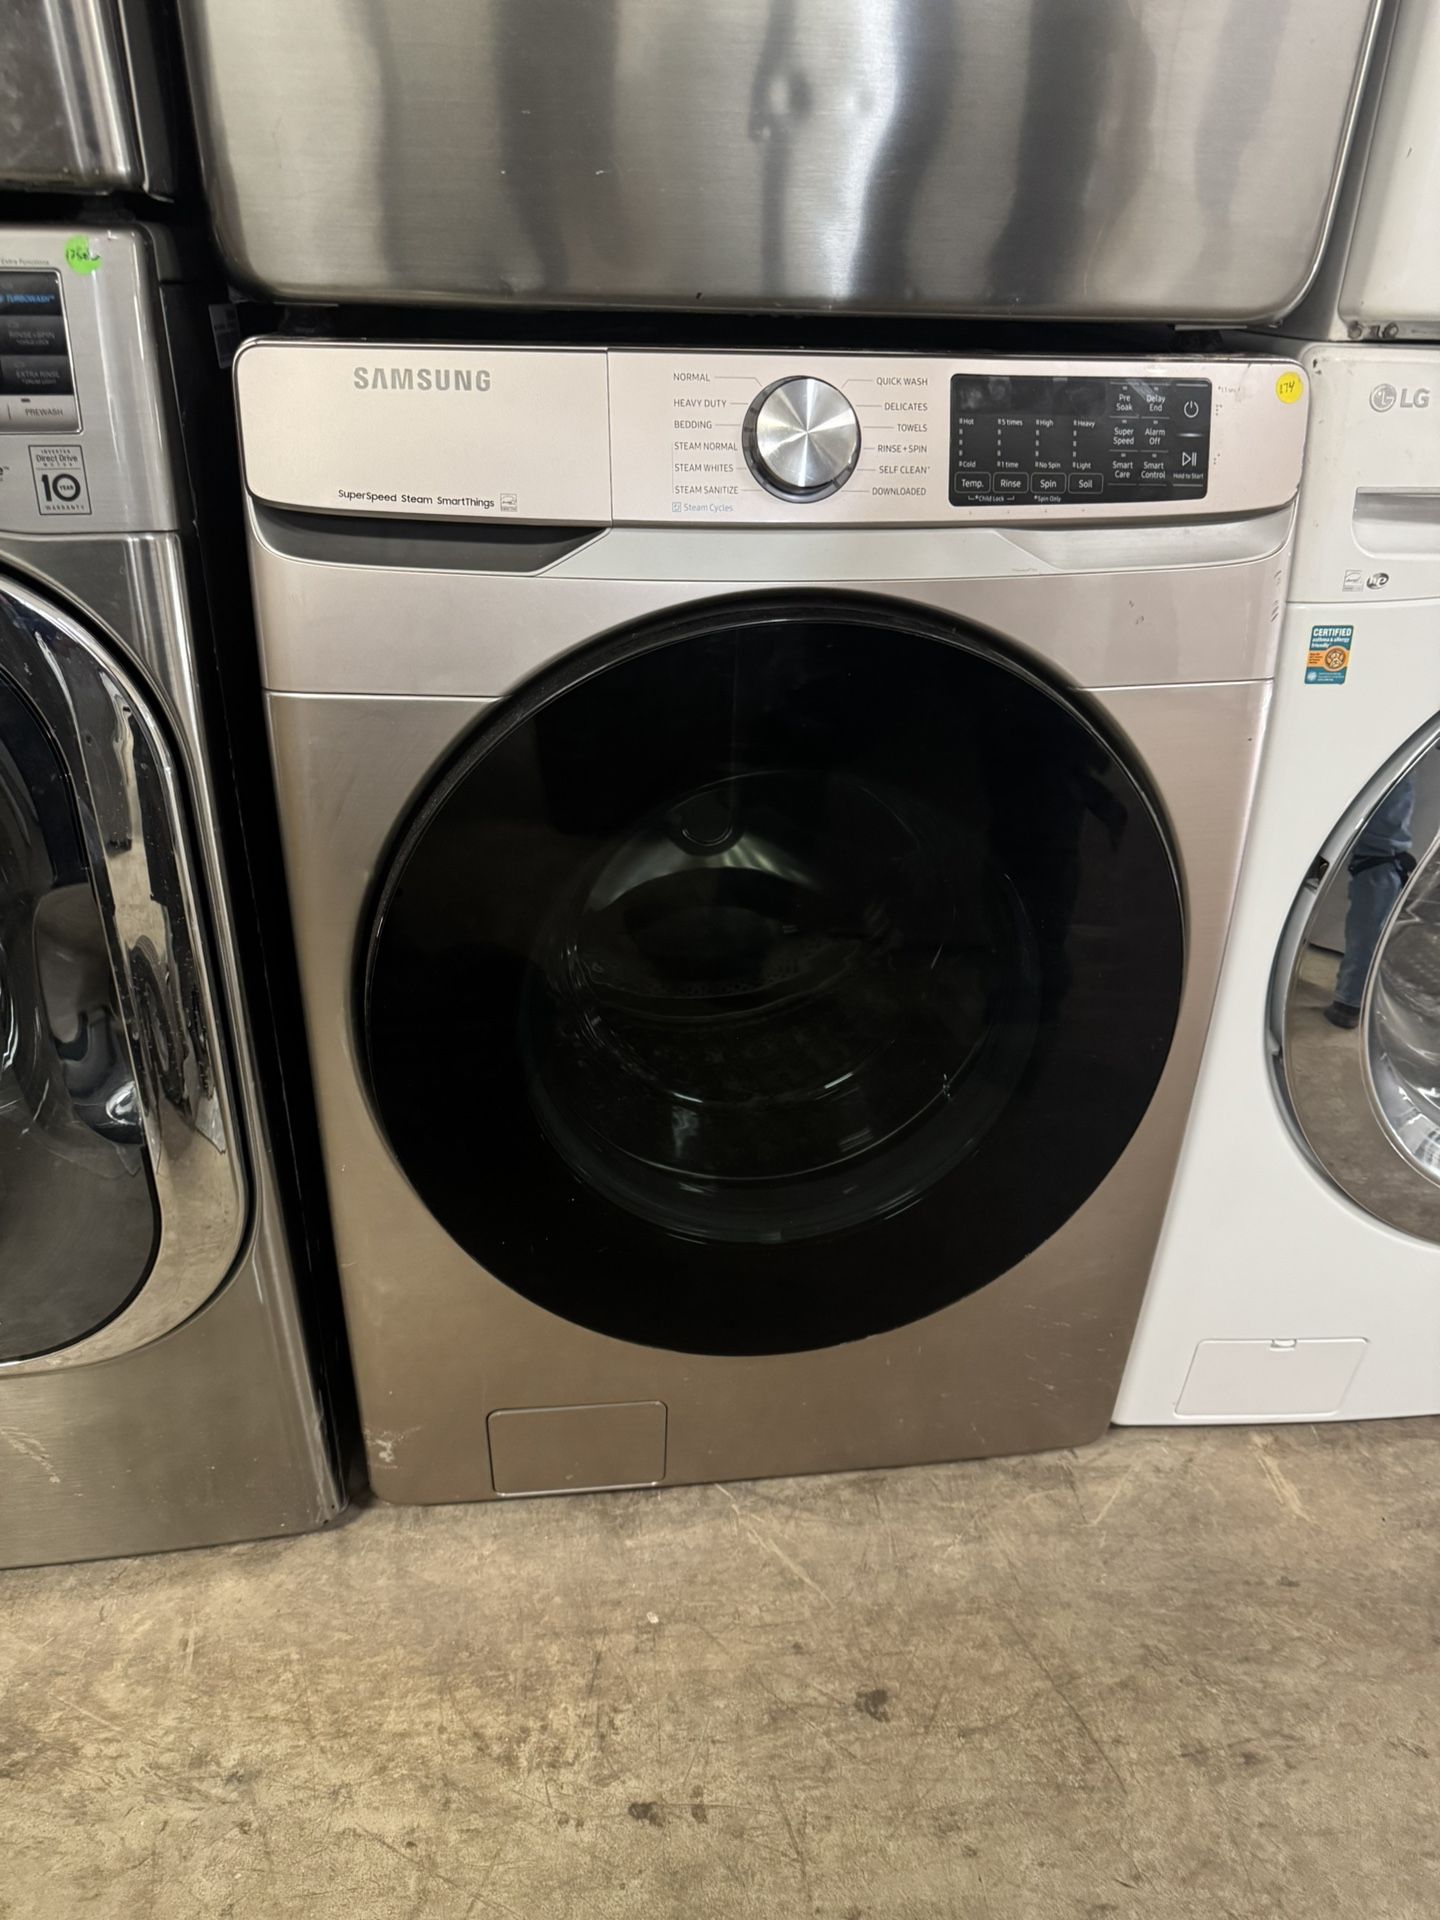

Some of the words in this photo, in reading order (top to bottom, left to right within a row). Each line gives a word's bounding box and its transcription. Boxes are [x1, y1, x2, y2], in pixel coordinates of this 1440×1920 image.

[353, 366, 491, 392] SAMSUNG
[673, 372, 711, 382] NORMAL
[876, 376, 901, 386] QUICK
[903, 377, 928, 387] WASH
[1118, 392, 1131, 402] Pre
[1146, 393, 1166, 403] Delay
[1399, 387, 1431, 409] LG
[673, 398, 702, 408] HEAVY
[703, 398, 727, 409] DUTY
[884, 402, 928, 412] DELICATES
[1116, 402, 1133, 412] Soak
[1149, 403, 1163, 412] End
[673, 419, 713, 430] BEDDING
[897, 423, 928, 433] TOWELS
[1006, 419, 1023, 427] times
[1039, 419, 1054, 428] High
[1077, 419, 1096, 429] Heavy
[1114, 427, 1134, 437] Super
[1144, 427, 1166, 437] Alarm
[1112, 436, 1135, 446] Speed
[1148, 437, 1161, 446] Off
[674, 441, 702, 451] STEAM
[703, 442, 739, 452] NORMAL
[36, 454, 57, 463] Direct
[59, 454, 78, 463] Drive
[674, 463, 702, 473] STEAM
[703, 463, 735, 473] WHITES
[962, 460, 977, 468] Cold
[1005, 460, 1019, 469] time
[1039, 461, 1048, 469] No
[1048, 461, 1062, 470] Spin
[1076, 461, 1092, 470] Light
[1112, 460, 1133, 470] Smart
[1143, 461, 1165, 471] Smart
[879, 465, 899, 474] SELF
[1114, 470, 1131, 480] Care
[1140, 470, 1166, 480] Control
[41, 473, 82, 503] 10
[961, 478, 985, 489] Temp.
[1000, 479, 1022, 489] Rinse
[1039, 479, 1058, 490] Spin
[1078, 479, 1093, 489] Soil
[674, 485, 702, 495] STEAM
[703, 485, 739, 495] SANITIZE
[871, 487, 927, 496] DOWNLOADED
[338, 489, 397, 503] SuperSpeed
[401, 494, 433, 505] Steam
[436, 496, 495, 509] SmartThings
[683, 502, 708, 512] Steam
[709, 503, 734, 514] Cycles
[1313, 627, 1352, 637] CERTIFIED
